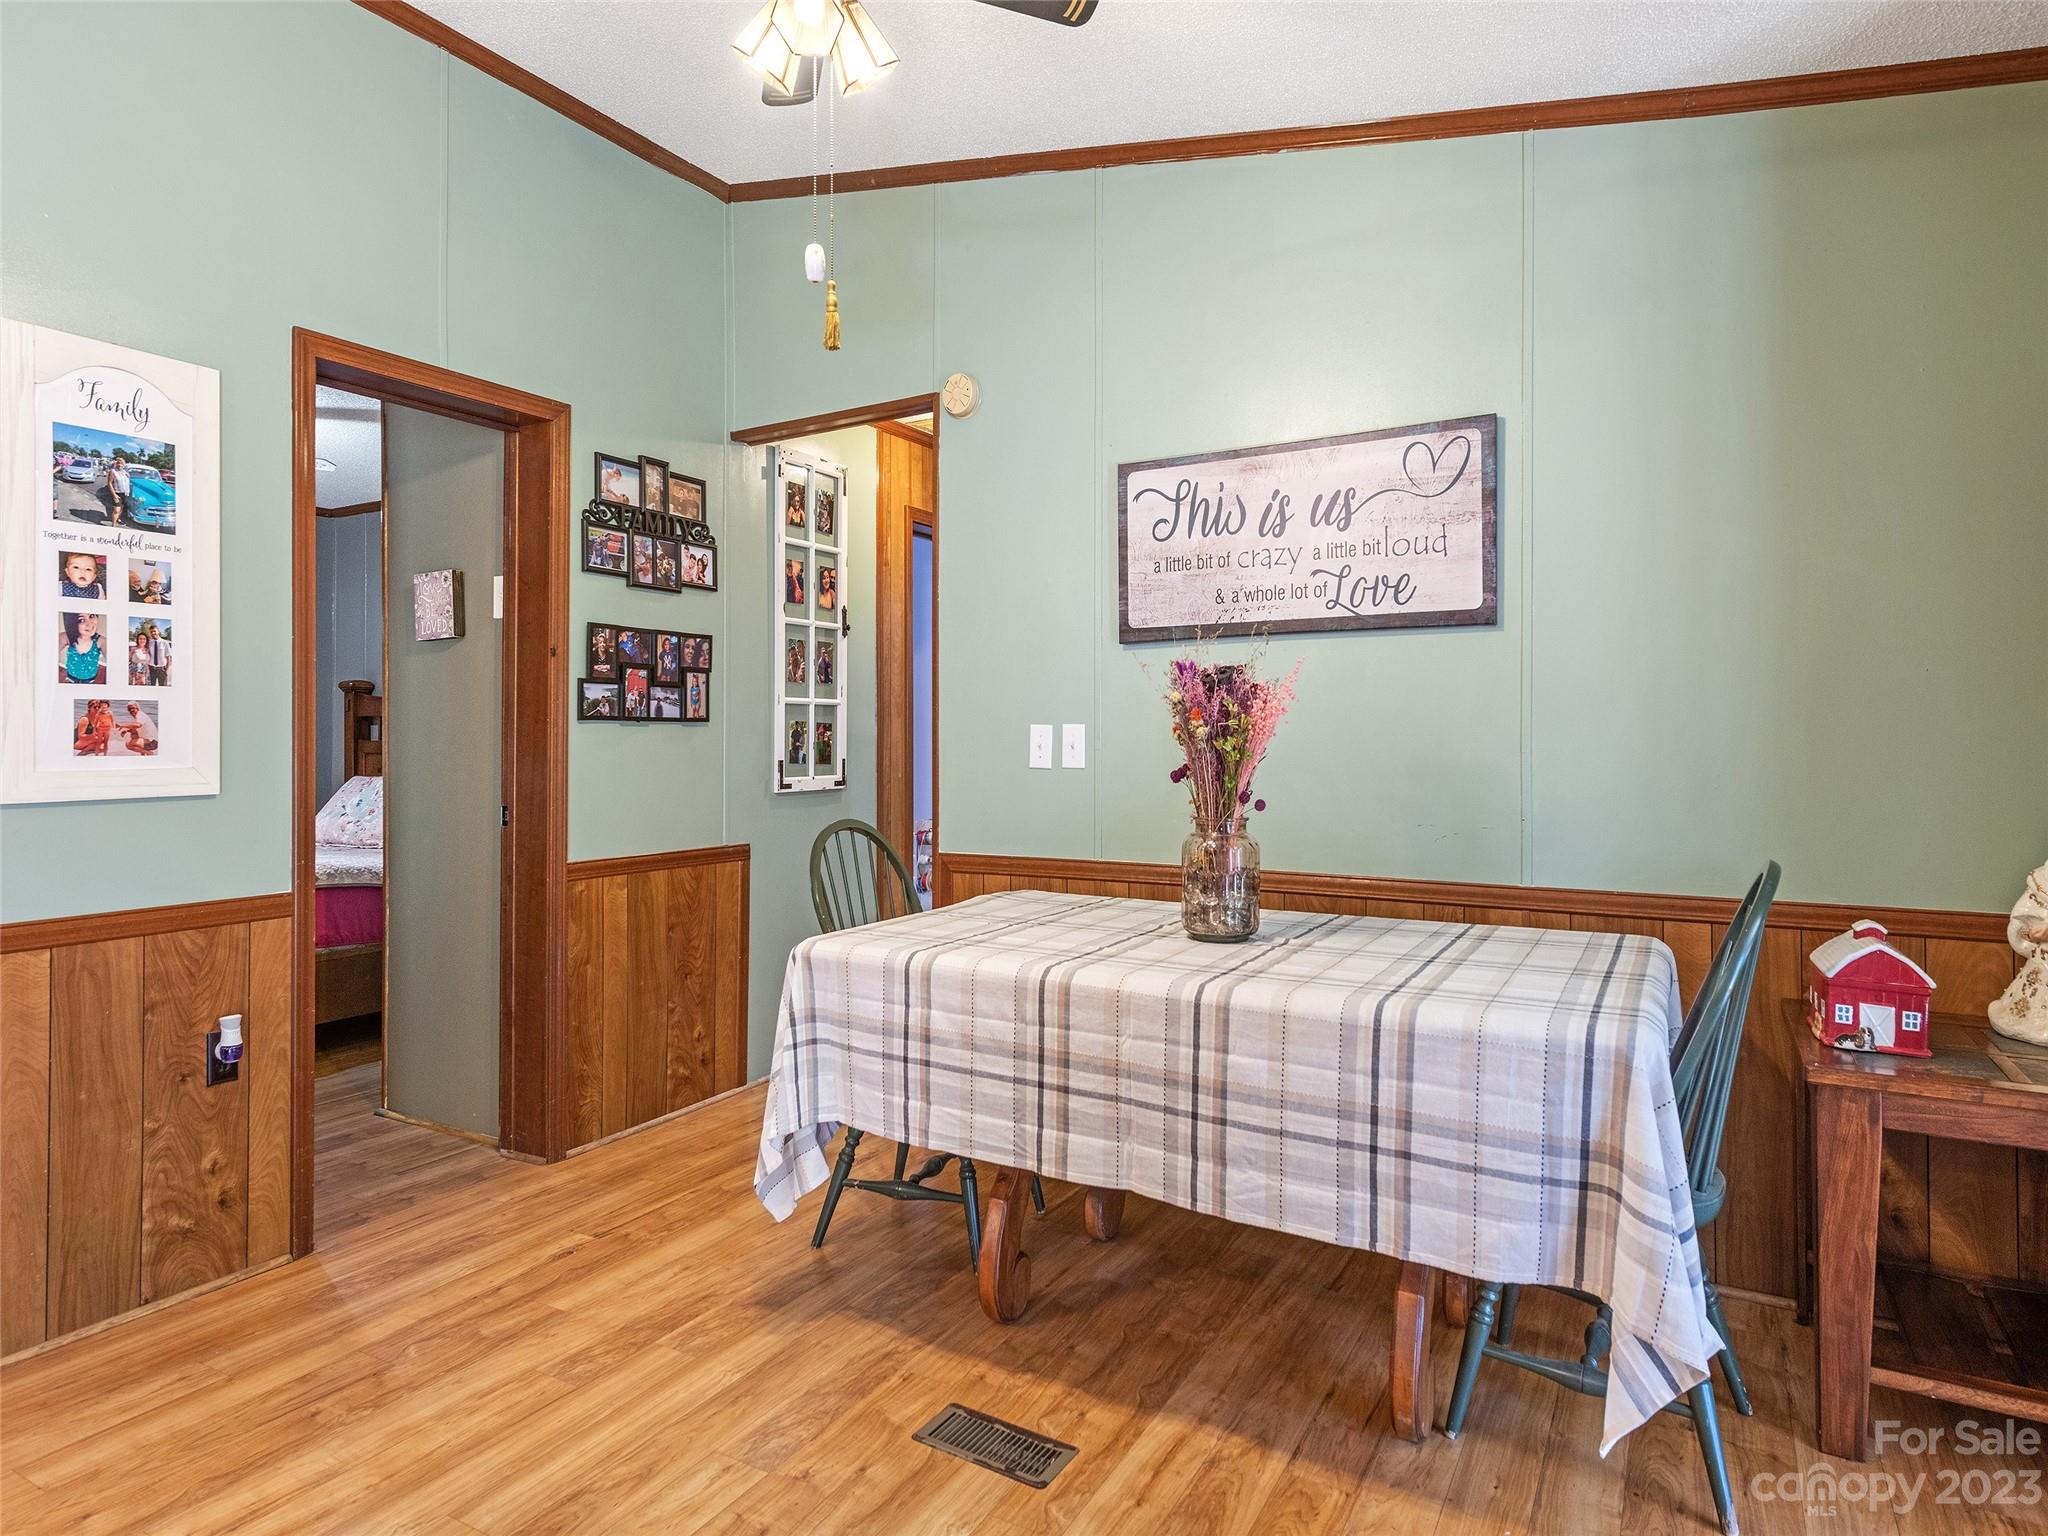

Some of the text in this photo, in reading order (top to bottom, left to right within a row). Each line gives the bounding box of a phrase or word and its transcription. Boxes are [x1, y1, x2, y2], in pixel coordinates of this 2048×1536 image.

[77, 378, 151, 432] Family
[621, 507, 690, 541] FAMILY
[1133, 479, 1357, 543] This is us
[42, 530, 77, 542] Together
[80, 534, 87, 542] is
[96, 532, 144, 554] wonderful
[144, 541, 162, 552] place
[164, 544, 171, 552] to
[174, 545, 182, 553] be
[1153, 523, 1449, 575] a little bit of crazy a little bit loud
[1215, 564, 1417, 617] & a whole lot of Love
[421, 618, 448, 635] LOVED
